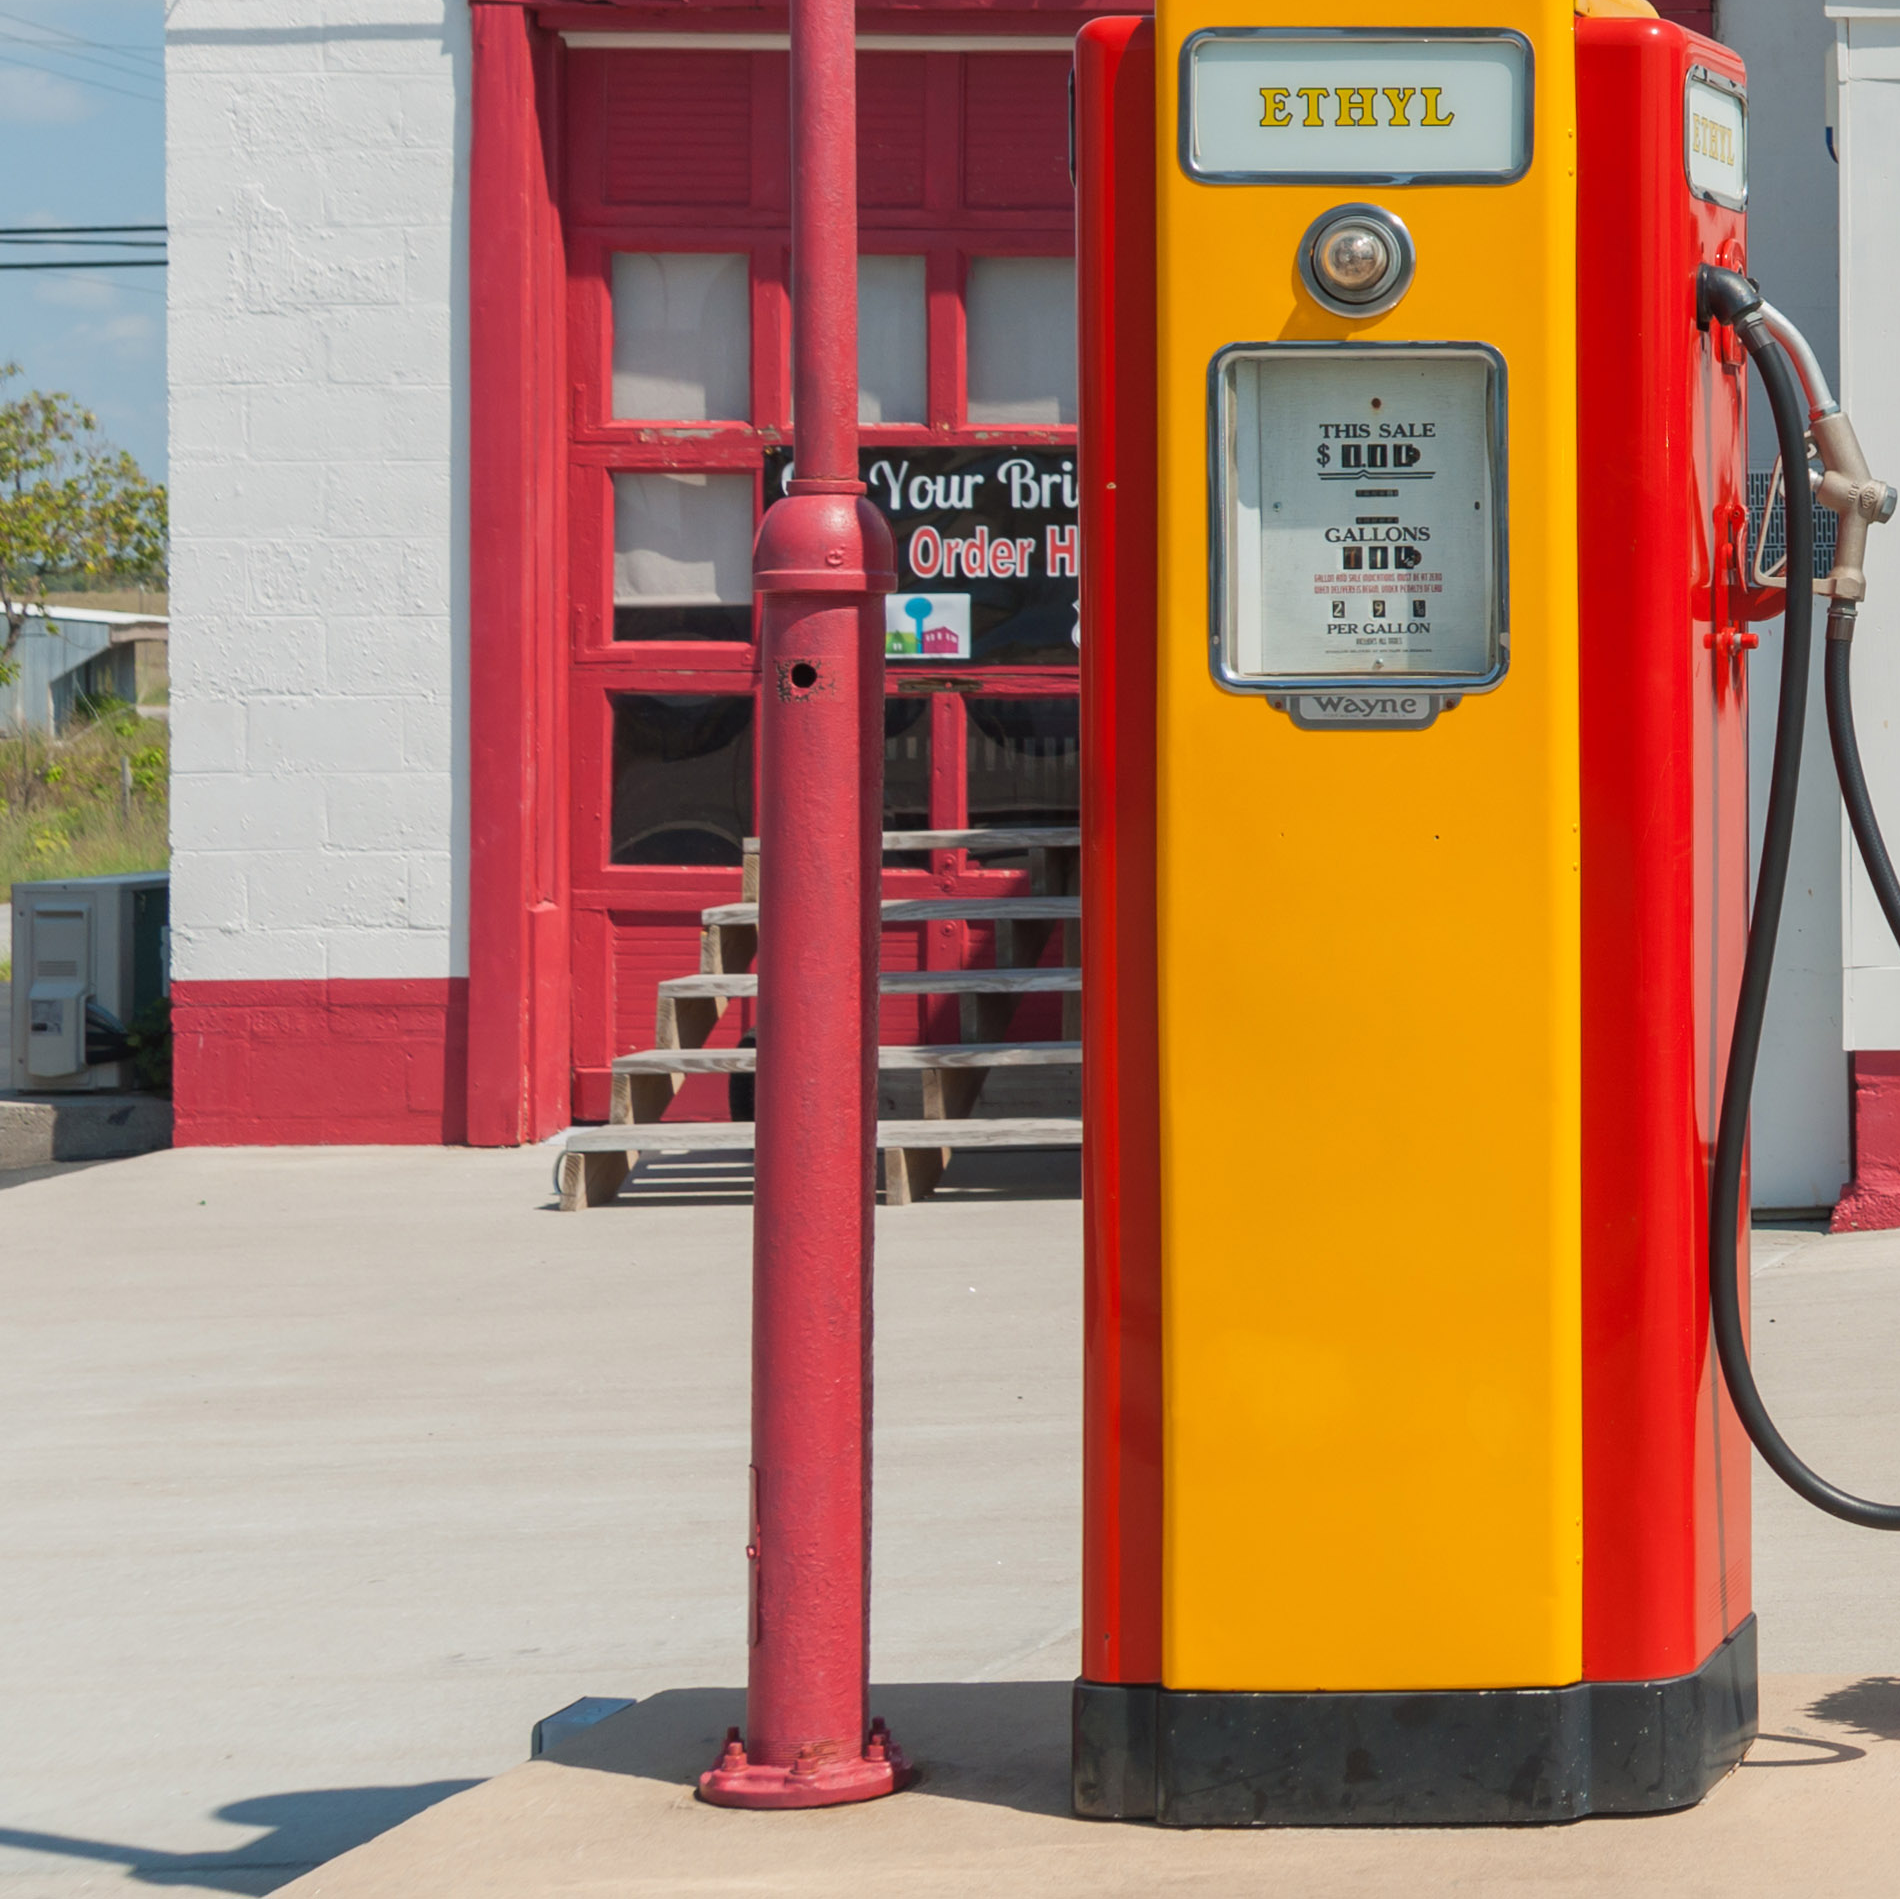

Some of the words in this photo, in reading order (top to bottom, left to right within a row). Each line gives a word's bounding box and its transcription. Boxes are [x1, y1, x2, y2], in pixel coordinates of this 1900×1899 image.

[1259, 87, 1455, 127] ETHYL
[1692, 112, 1736, 167] ETHYL
[1319, 423, 1371, 439] THIS
[1379, 422, 1436, 438] SALE
[869, 459, 984, 510] Your
[997, 458, 1080, 510] Bri
[1324, 526, 1431, 543] GALLONS
[908, 525, 1036, 579] Order
[1332, 601, 1343, 617] 2
[1374, 601, 1384, 617] 9
[1327, 623, 1358, 635] PER
[1363, 622, 1431, 635] GALLON
[1312, 696, 1417, 717] Wayne
